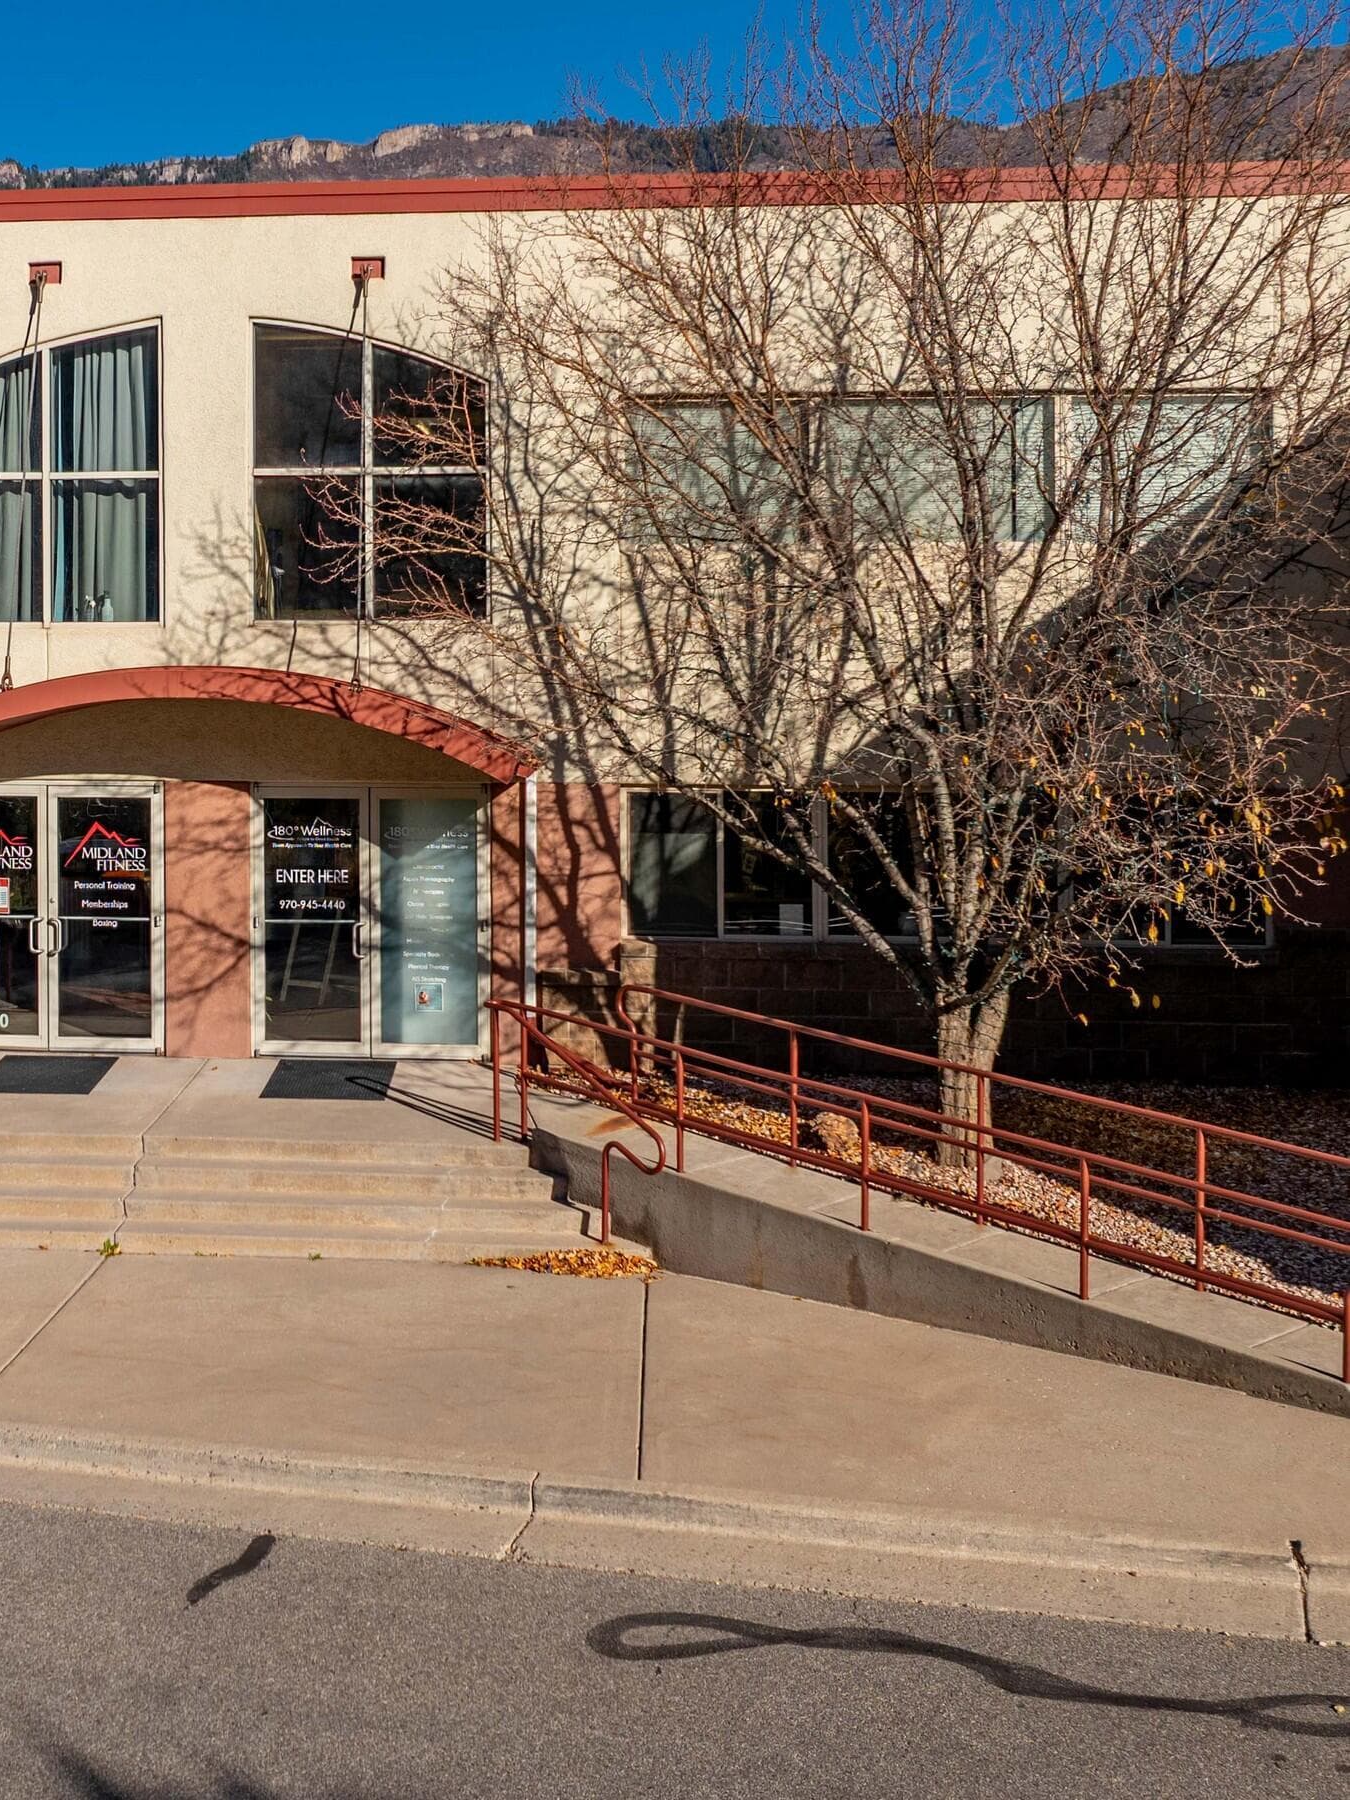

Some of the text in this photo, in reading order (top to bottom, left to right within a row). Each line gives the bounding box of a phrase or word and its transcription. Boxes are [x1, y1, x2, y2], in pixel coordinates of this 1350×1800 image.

[300, 824, 352, 836] Wellness
[81, 847, 146, 860] MIDLAND
[96, 860, 146, 872] FITNESS
[276, 869, 349, 884] ENTER HERE
[74, 880, 136, 891] Personal Training
[81, 899, 128, 910] Memberships
[279, 899, 346, 910] 970-945-4440
[92, 918, 118, 928] Boxing
